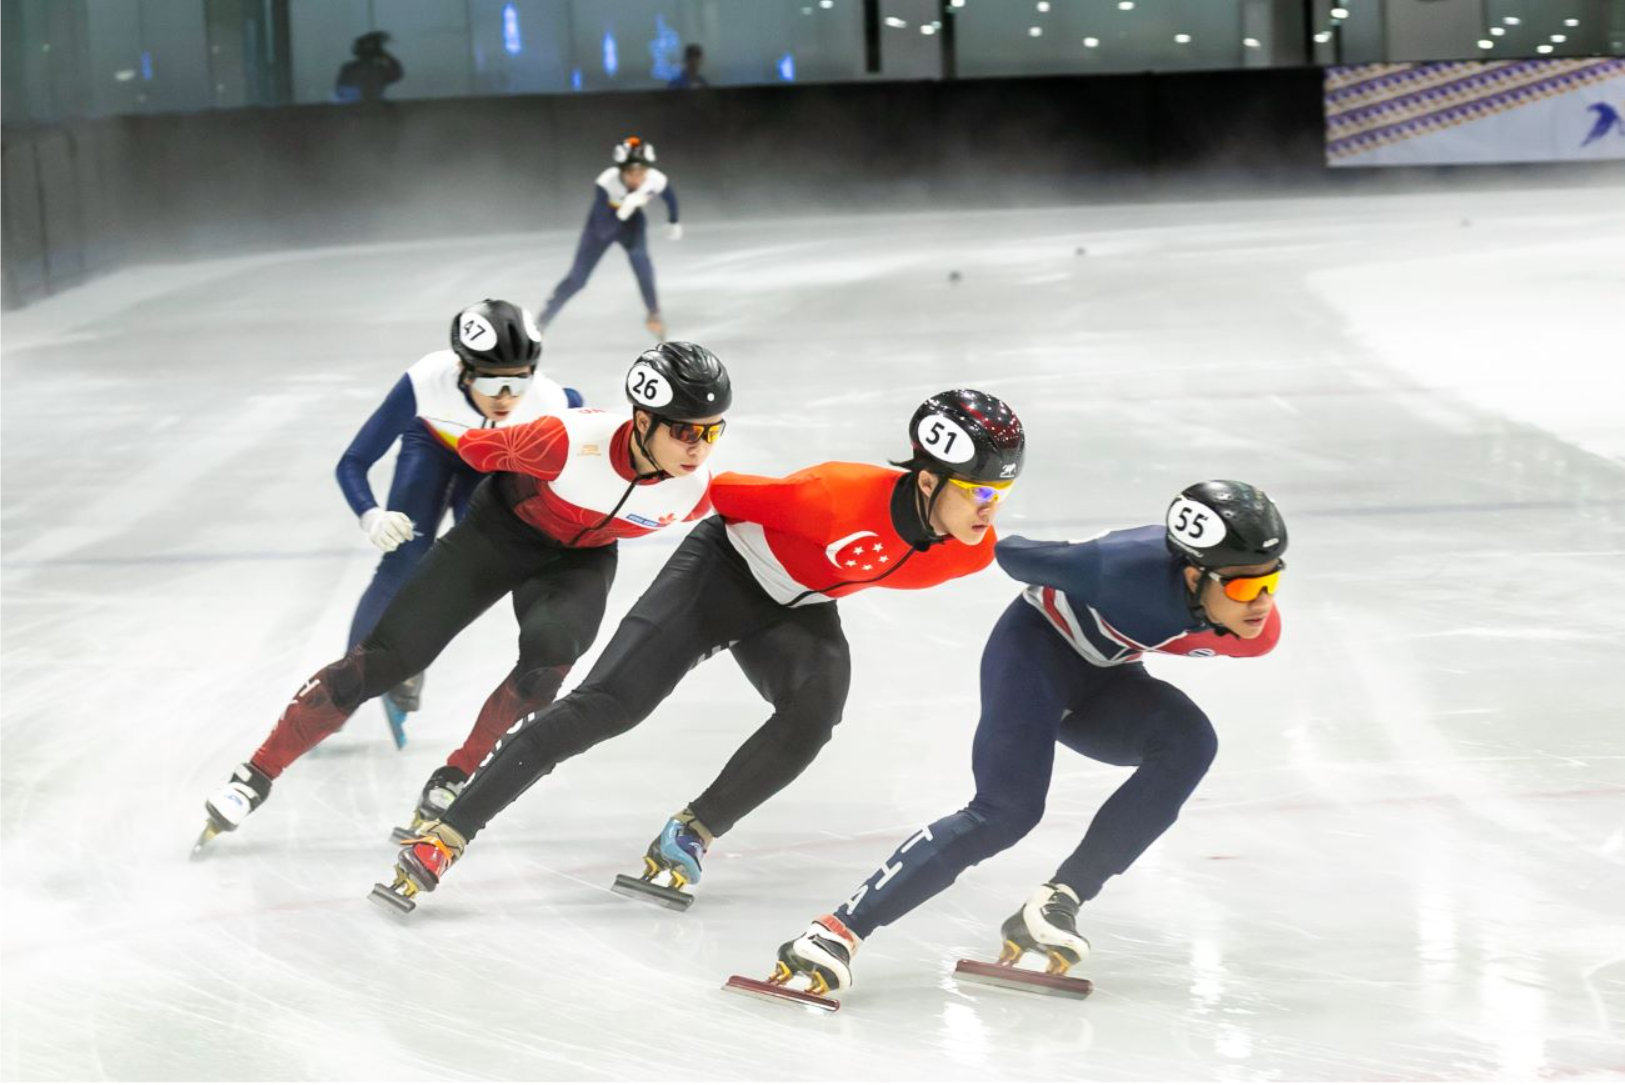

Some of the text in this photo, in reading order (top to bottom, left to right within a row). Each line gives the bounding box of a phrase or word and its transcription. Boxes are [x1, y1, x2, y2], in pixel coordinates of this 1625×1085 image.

[463, 319, 487, 341] 47
[632, 371, 659, 400] 26
[925, 421, 957, 455] 51
[1174, 506, 1209, 539] 55
